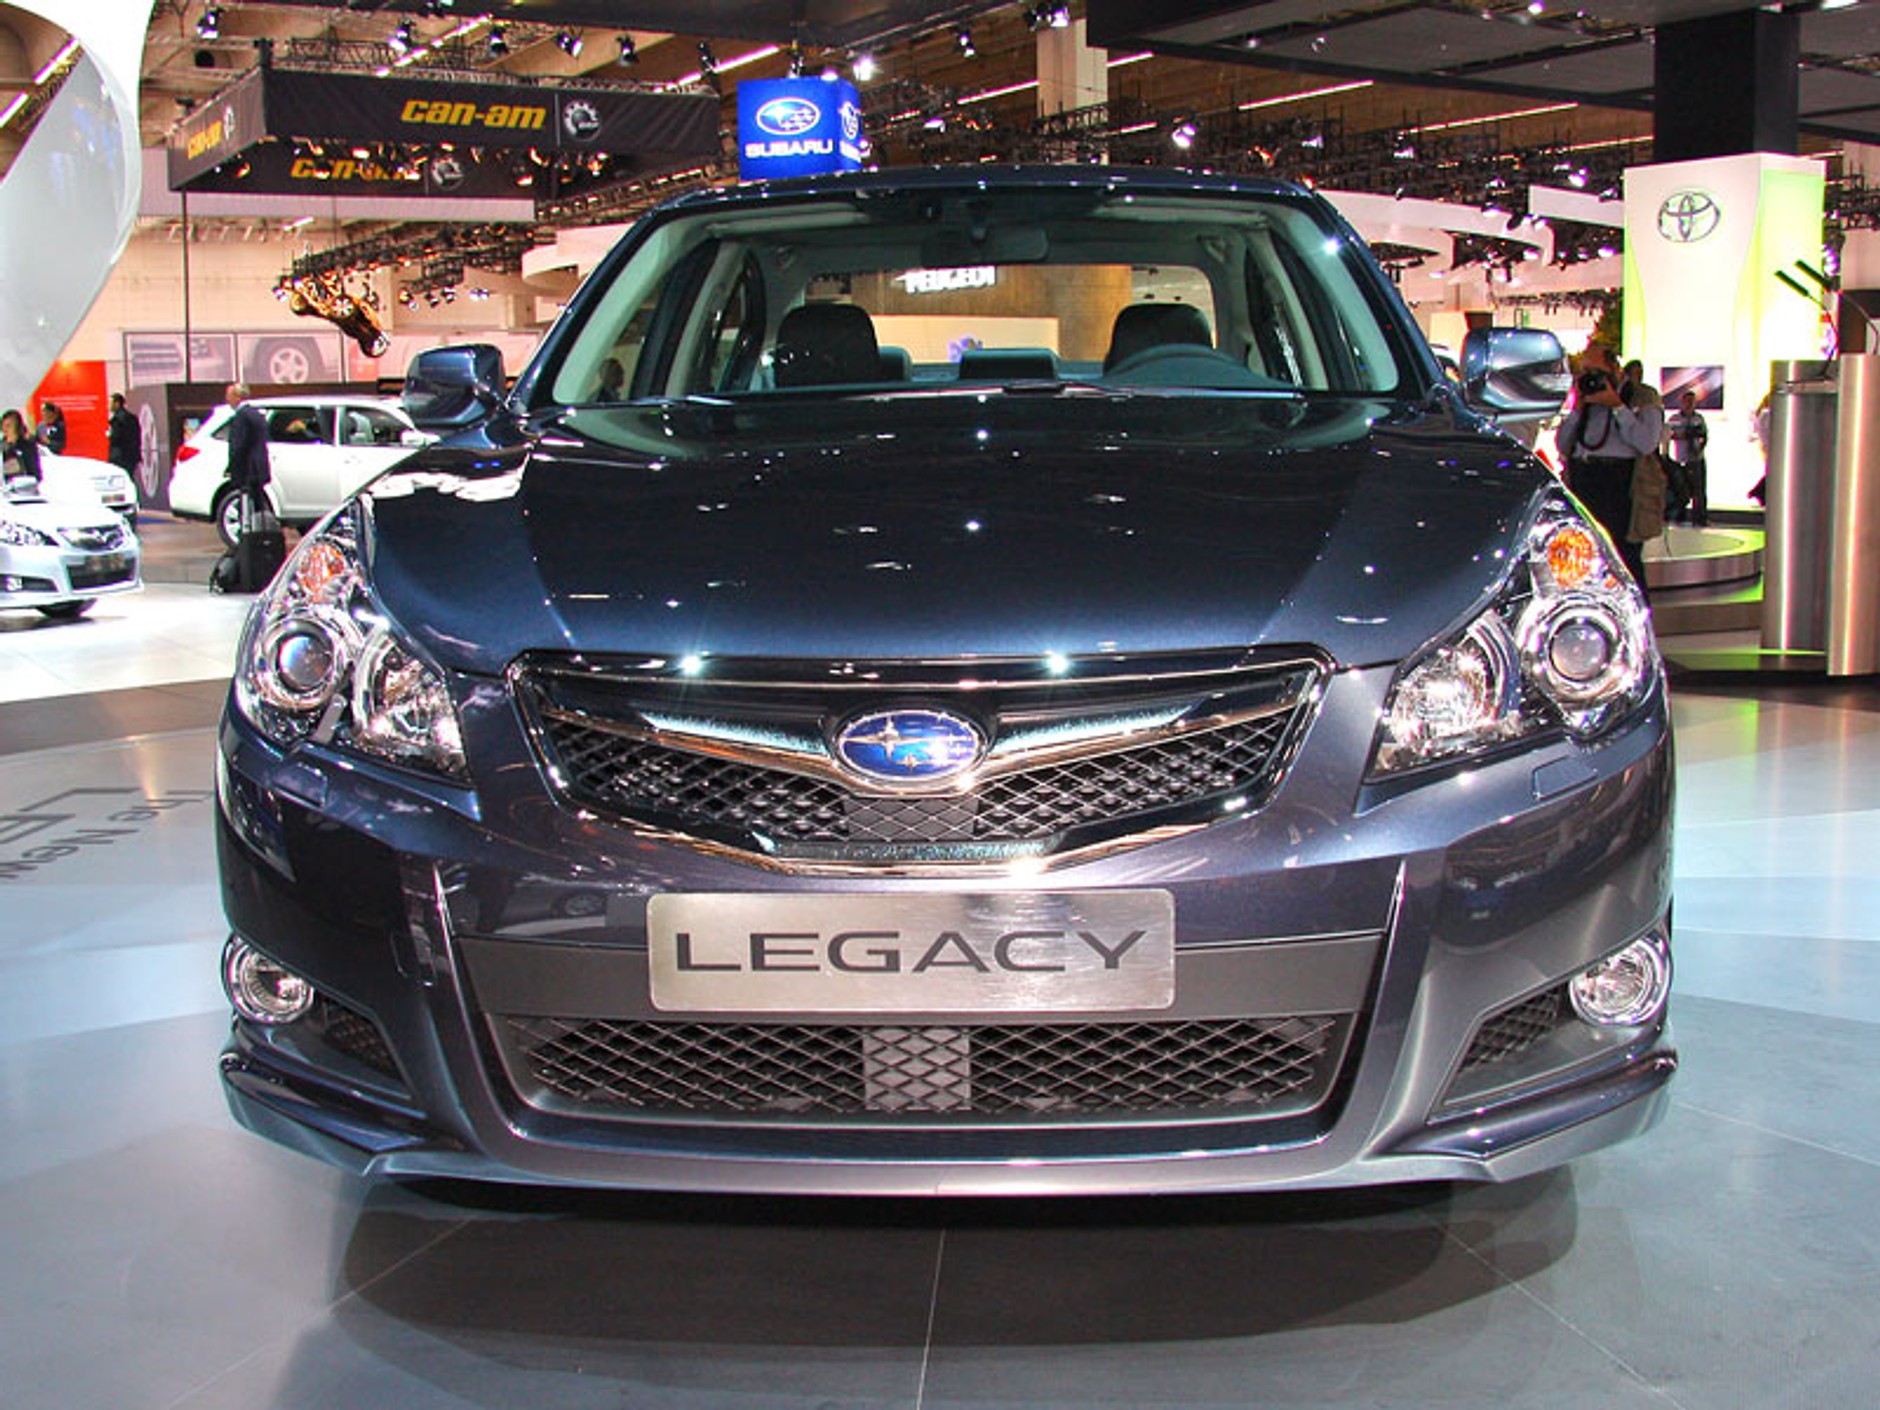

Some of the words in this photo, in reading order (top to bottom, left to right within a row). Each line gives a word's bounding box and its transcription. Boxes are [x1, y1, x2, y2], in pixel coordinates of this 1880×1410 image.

[401, 99, 546, 130] can-am
[745, 139, 833, 158] SUBARU
[676, 931, 1146, 973] LEGACY
